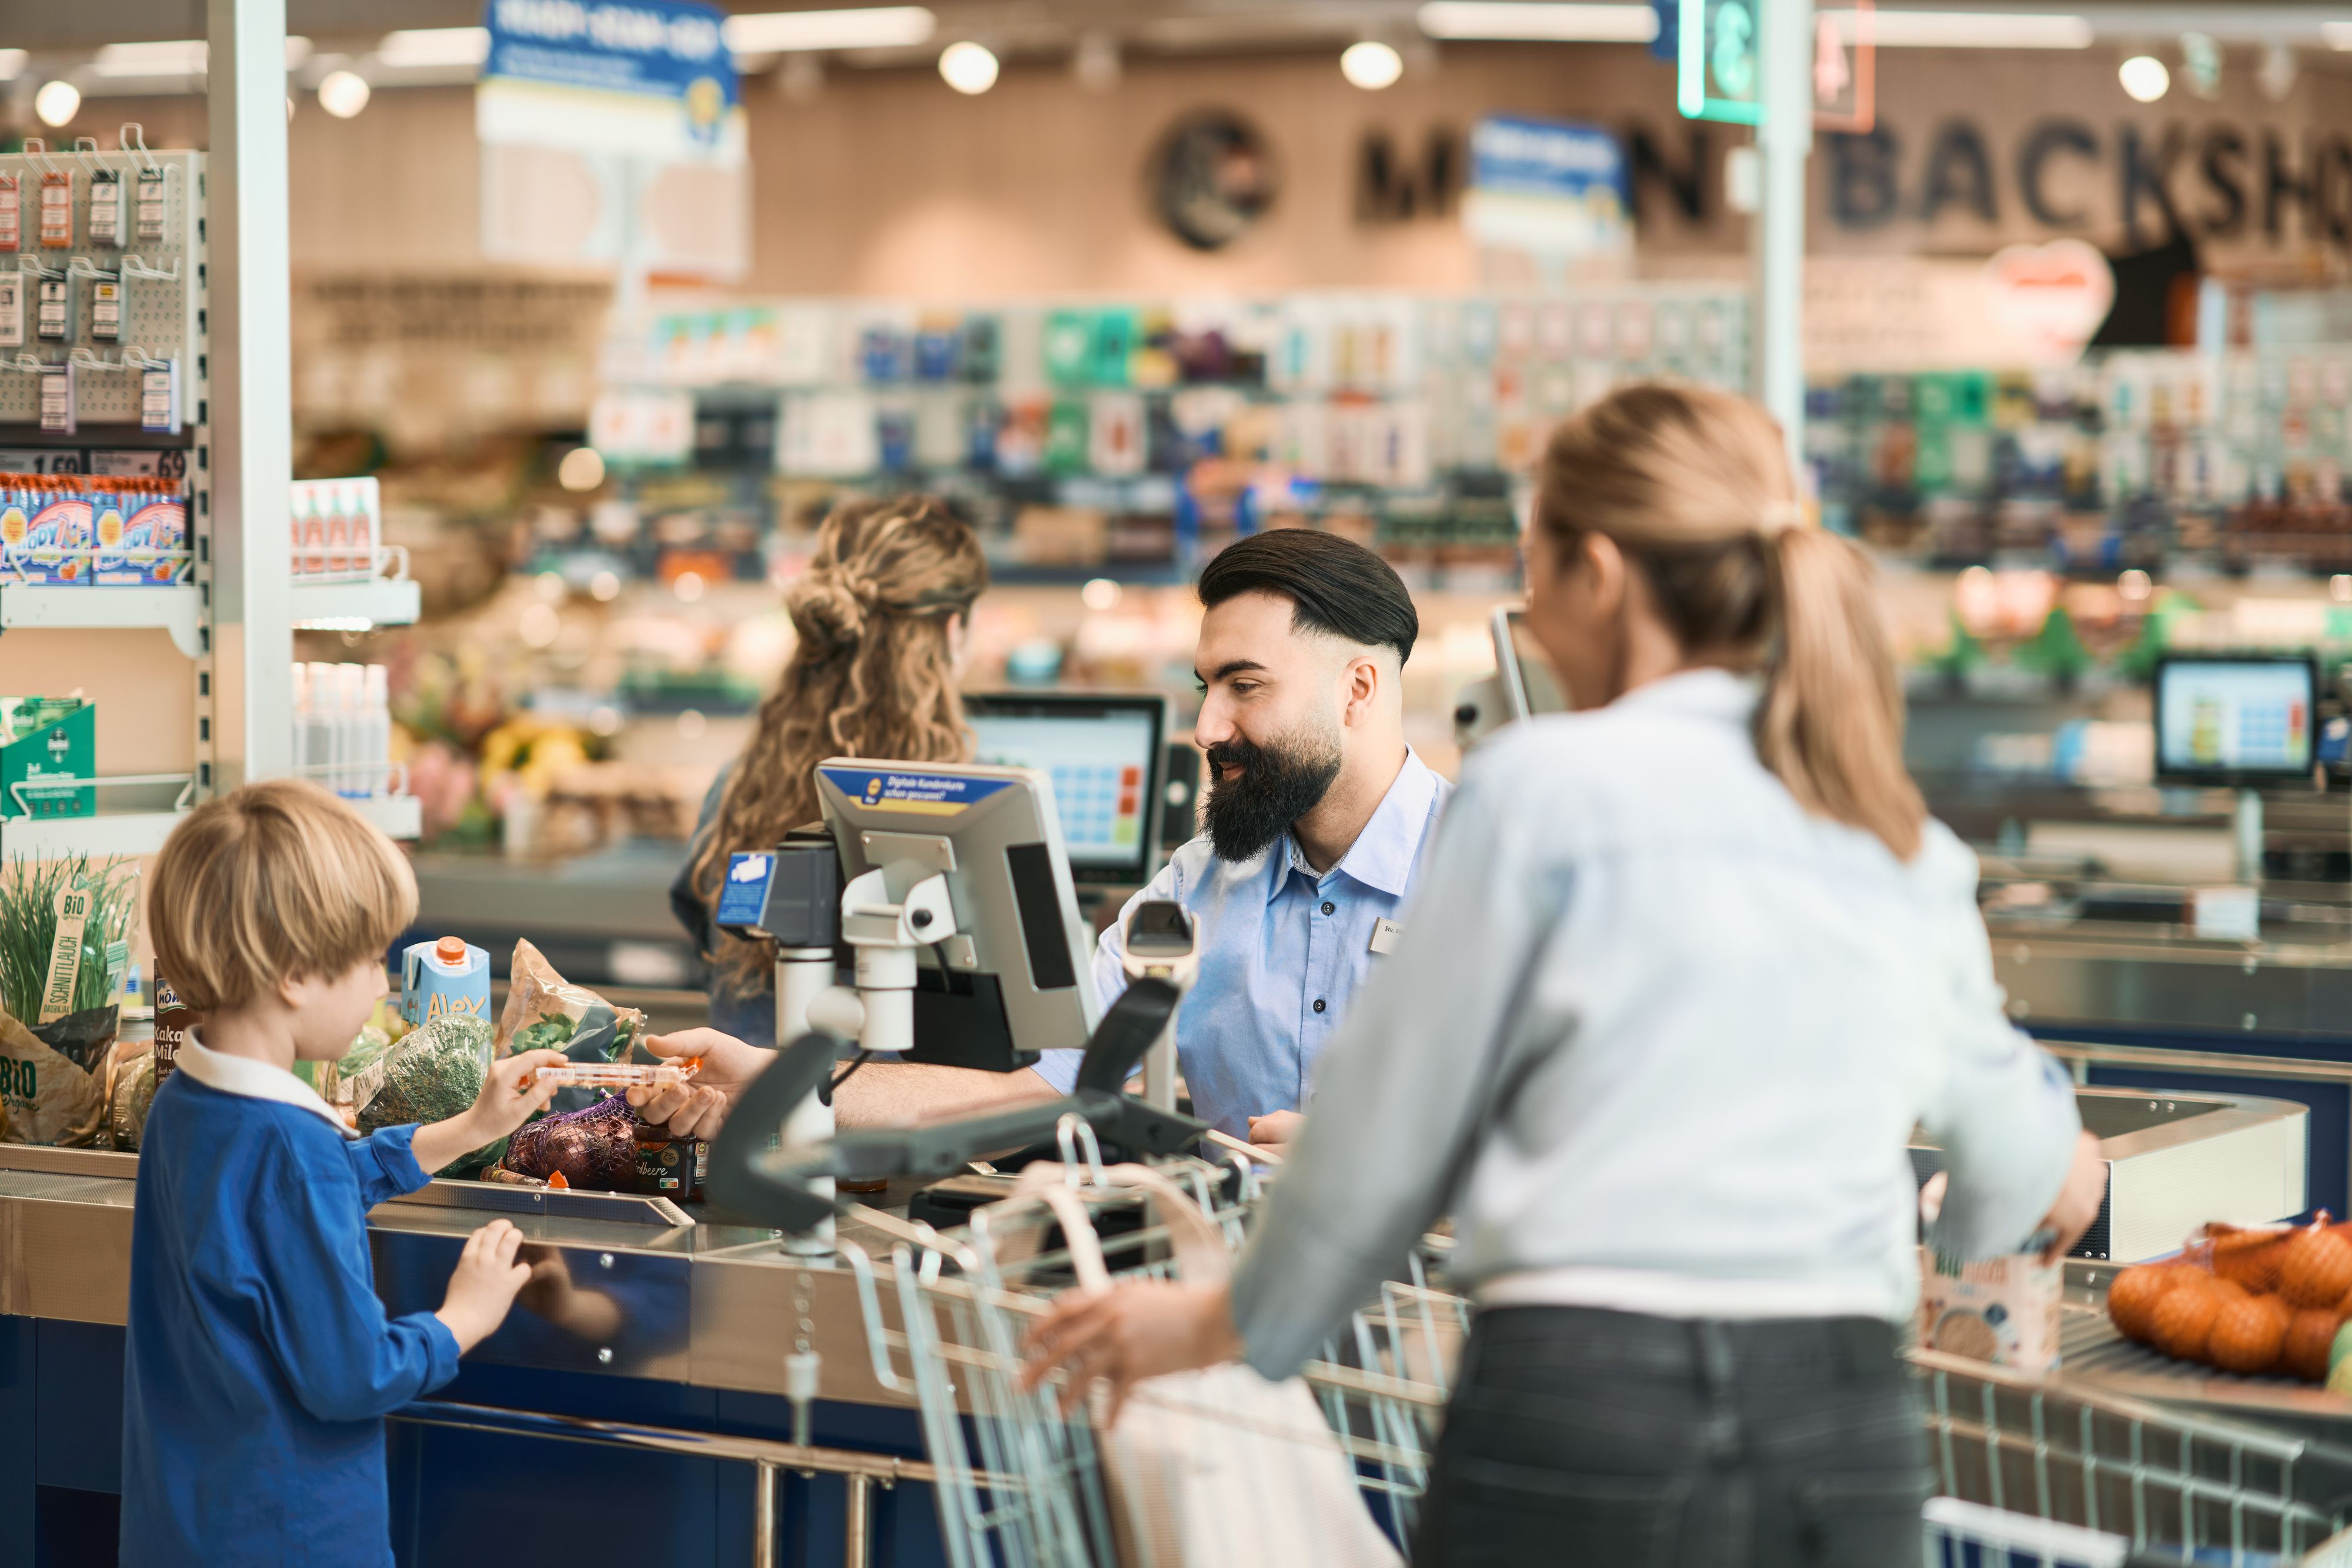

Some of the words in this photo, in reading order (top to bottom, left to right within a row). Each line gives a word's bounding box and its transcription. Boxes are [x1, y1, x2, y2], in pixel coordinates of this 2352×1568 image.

[1351, 122, 1716, 229] MN
[49, 936, 78, 1004] SCHNITTLAUCH
[155, 1025, 183, 1042] Kaka
[636, 1161, 668, 1175] rdbeere
